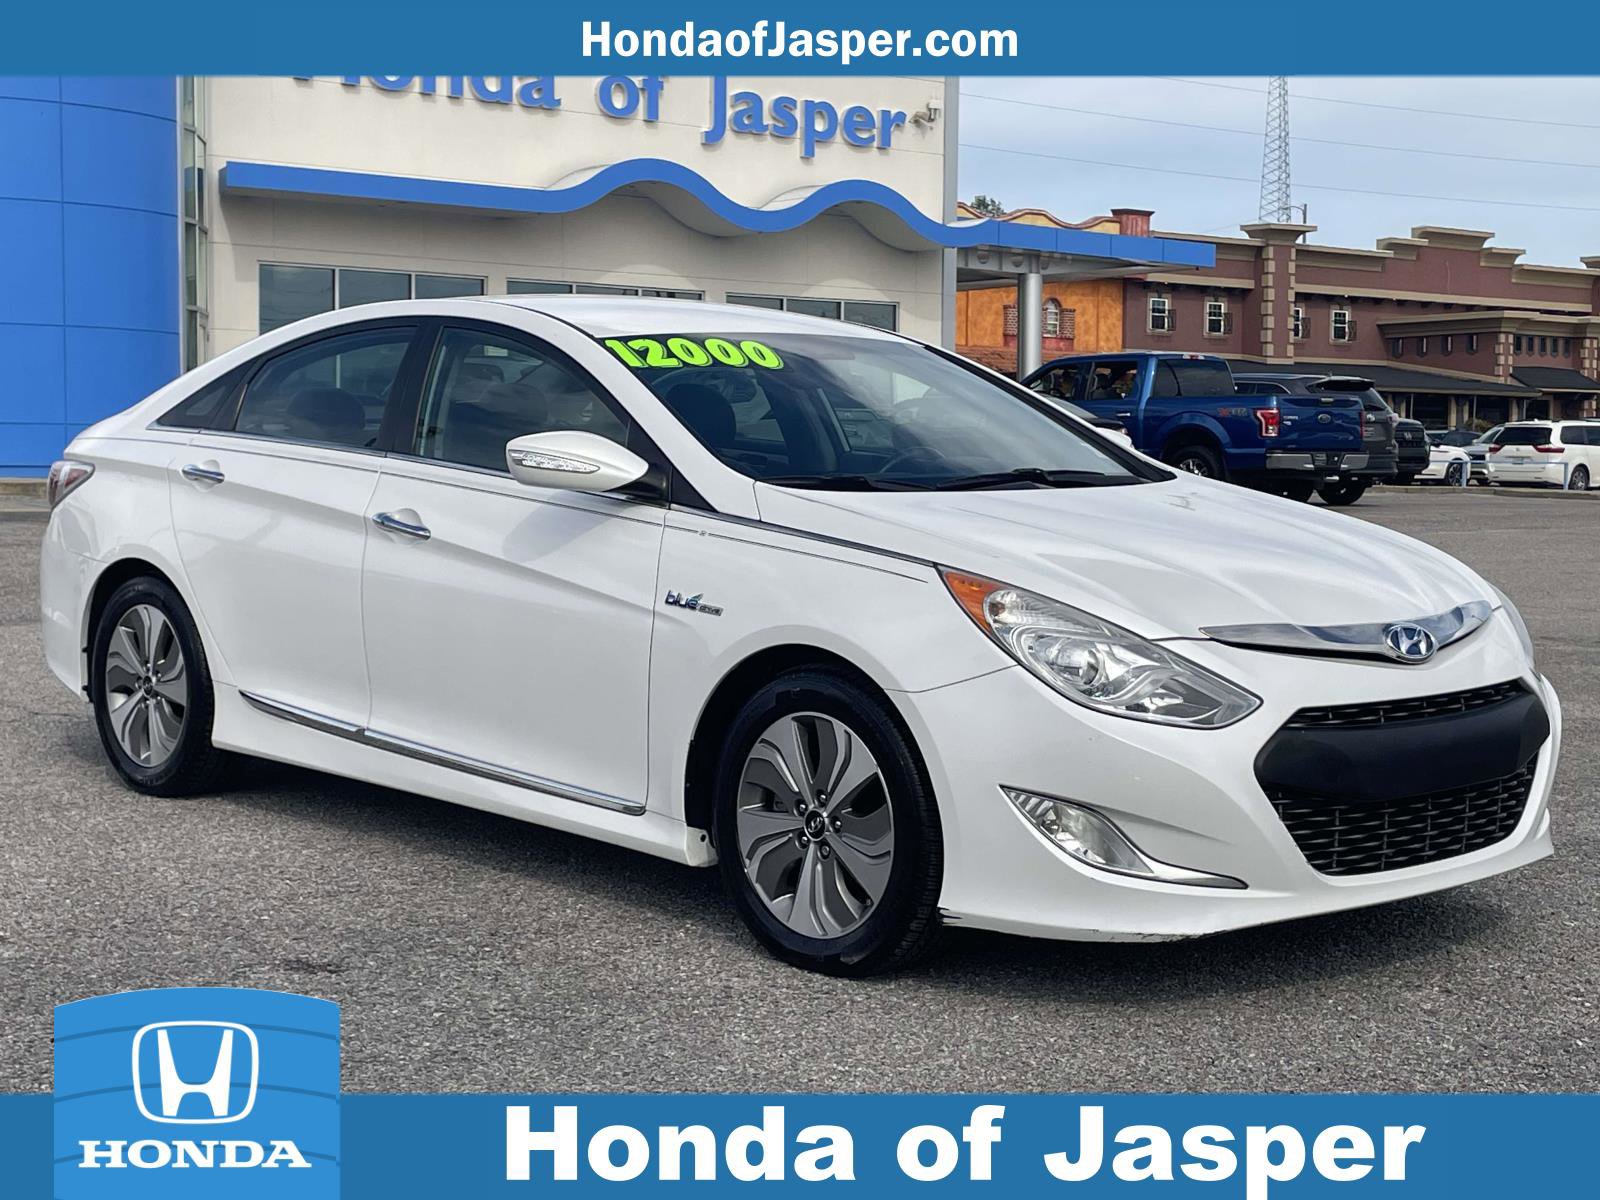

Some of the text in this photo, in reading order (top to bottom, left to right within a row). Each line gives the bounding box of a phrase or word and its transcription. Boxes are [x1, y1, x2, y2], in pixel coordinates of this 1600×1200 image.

[596, 76, 665, 122] of
[701, 76, 908, 158] Jasper
[604, 337, 784, 368] 12000
